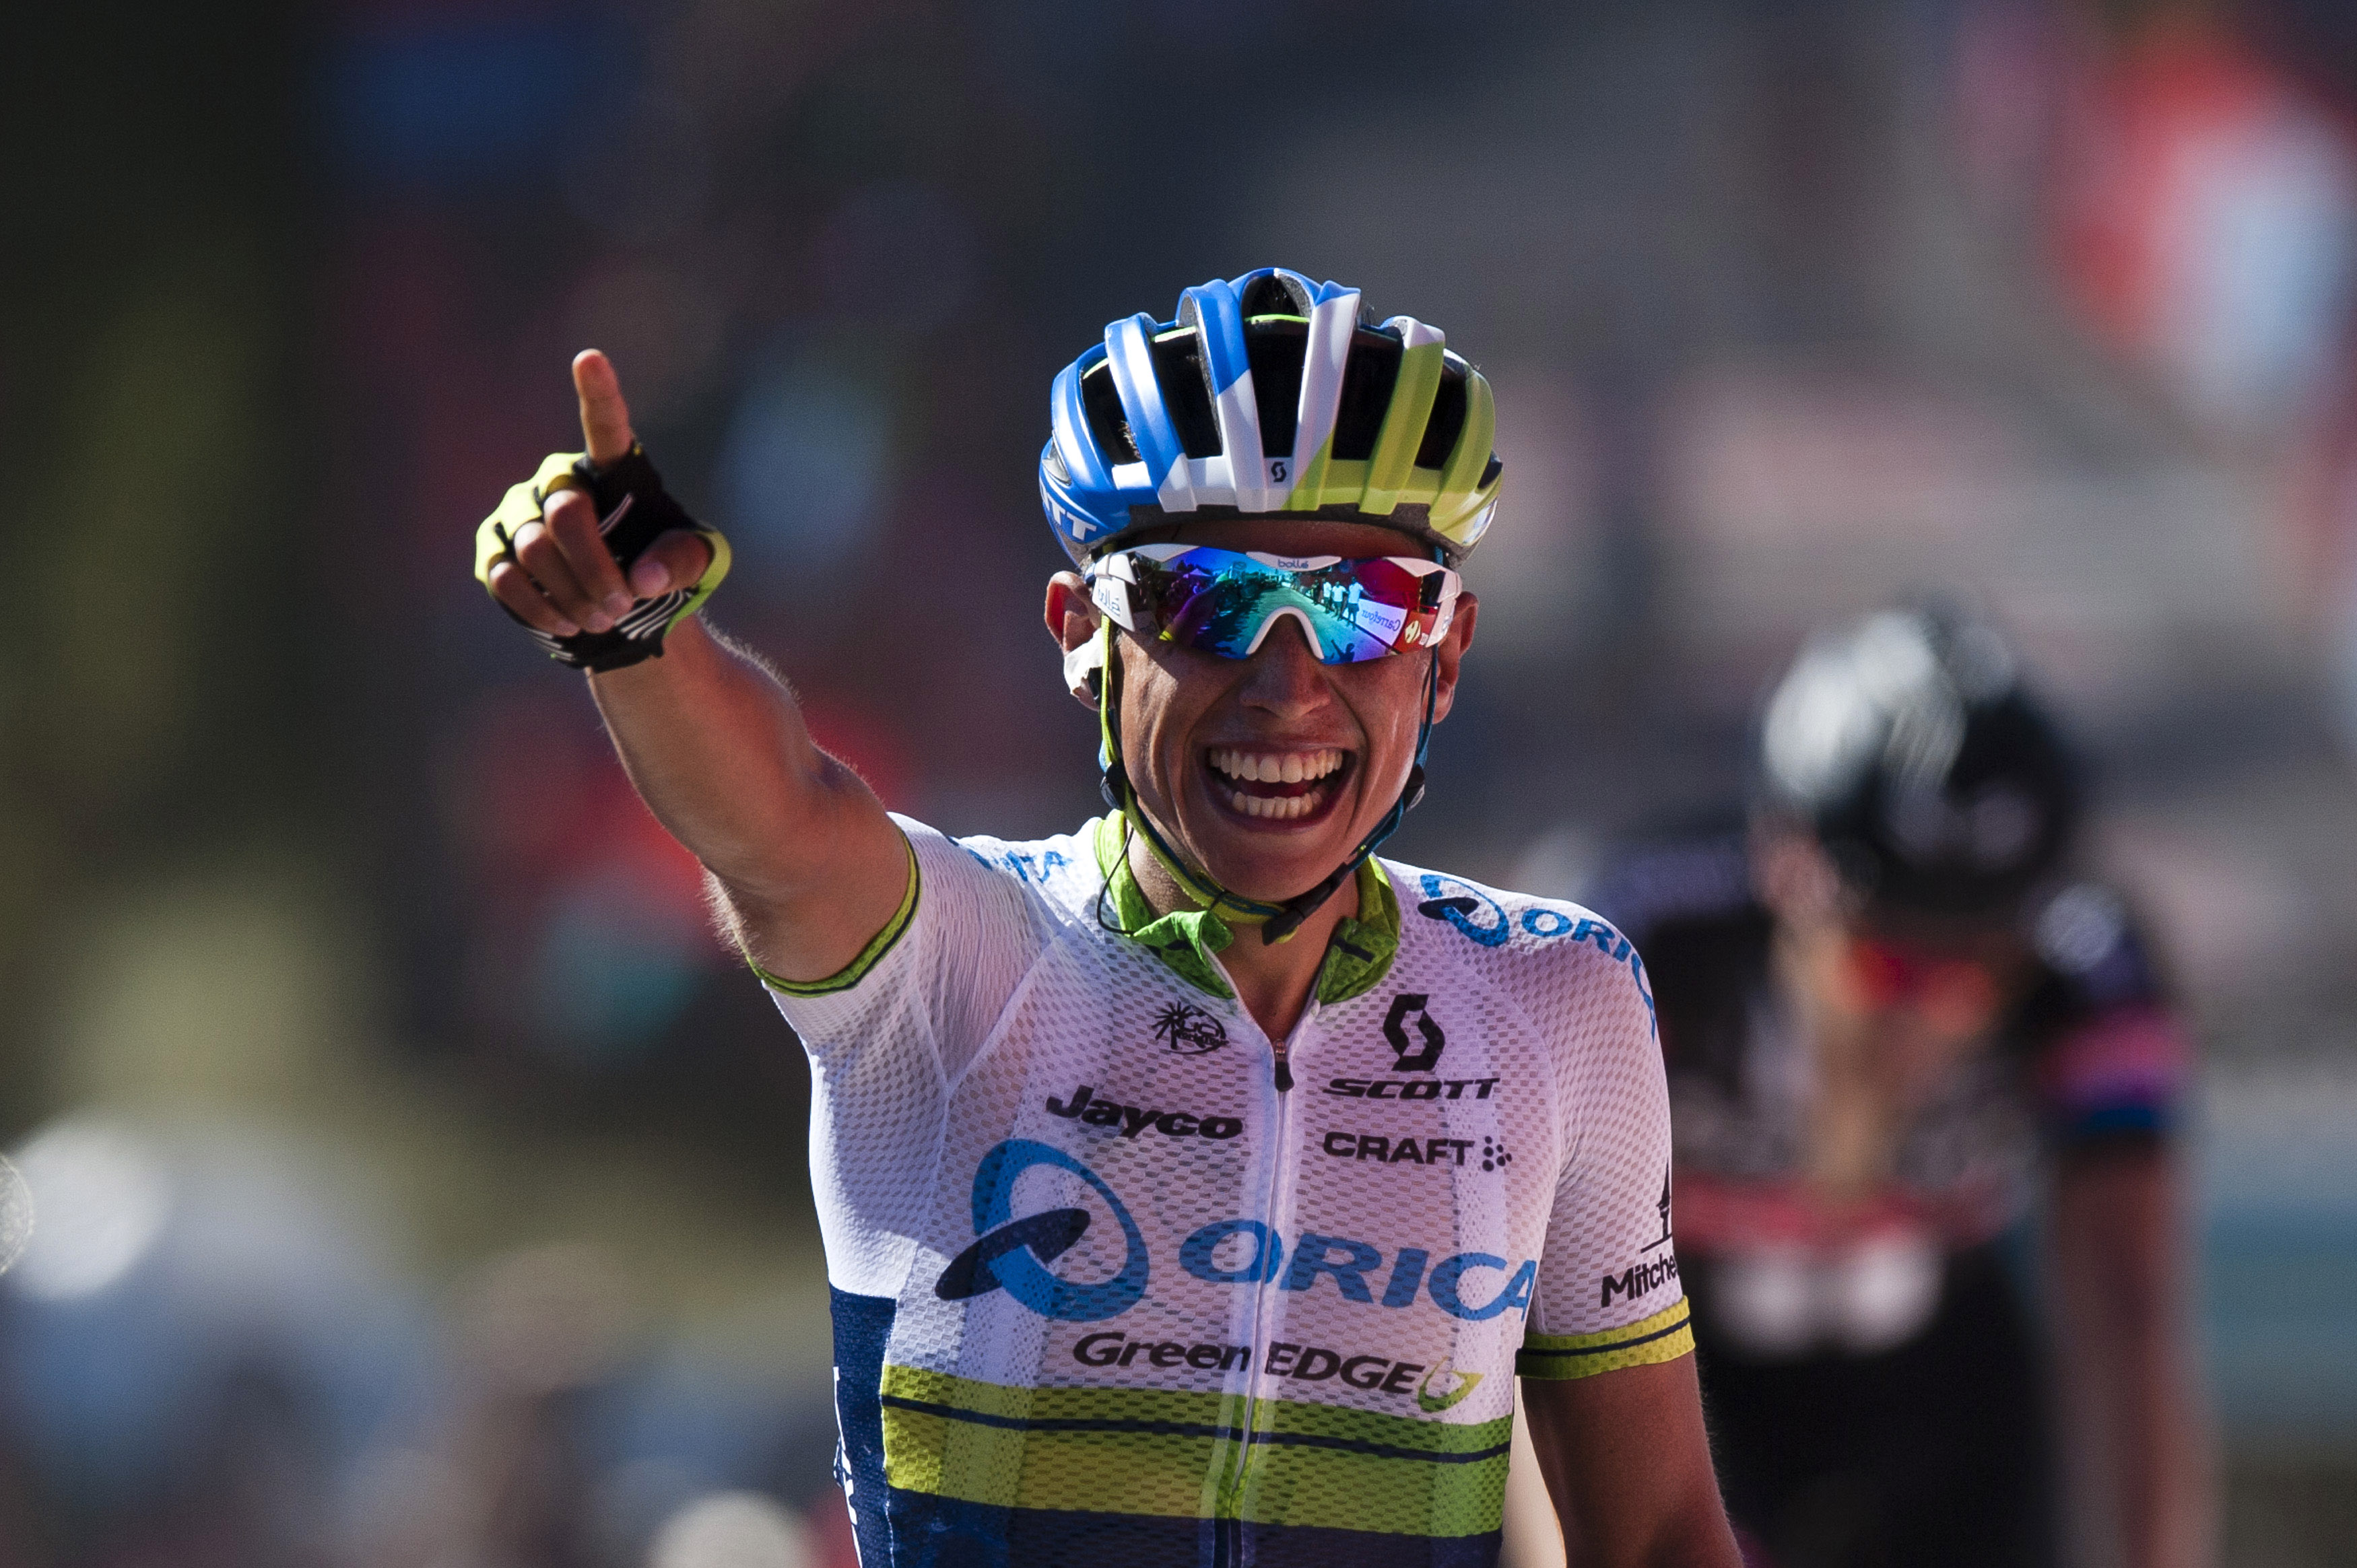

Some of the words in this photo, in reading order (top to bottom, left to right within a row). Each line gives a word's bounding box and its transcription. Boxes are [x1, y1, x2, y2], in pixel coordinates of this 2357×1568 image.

[1277, 559, 1308, 568] bollé
[1323, 1078, 1500, 1100] SCOTT
[1046, 1085, 1244, 1138] Jayco
[1323, 1131, 1475, 1167] CRAFT
[1179, 1219, 1537, 1322] ORICA
